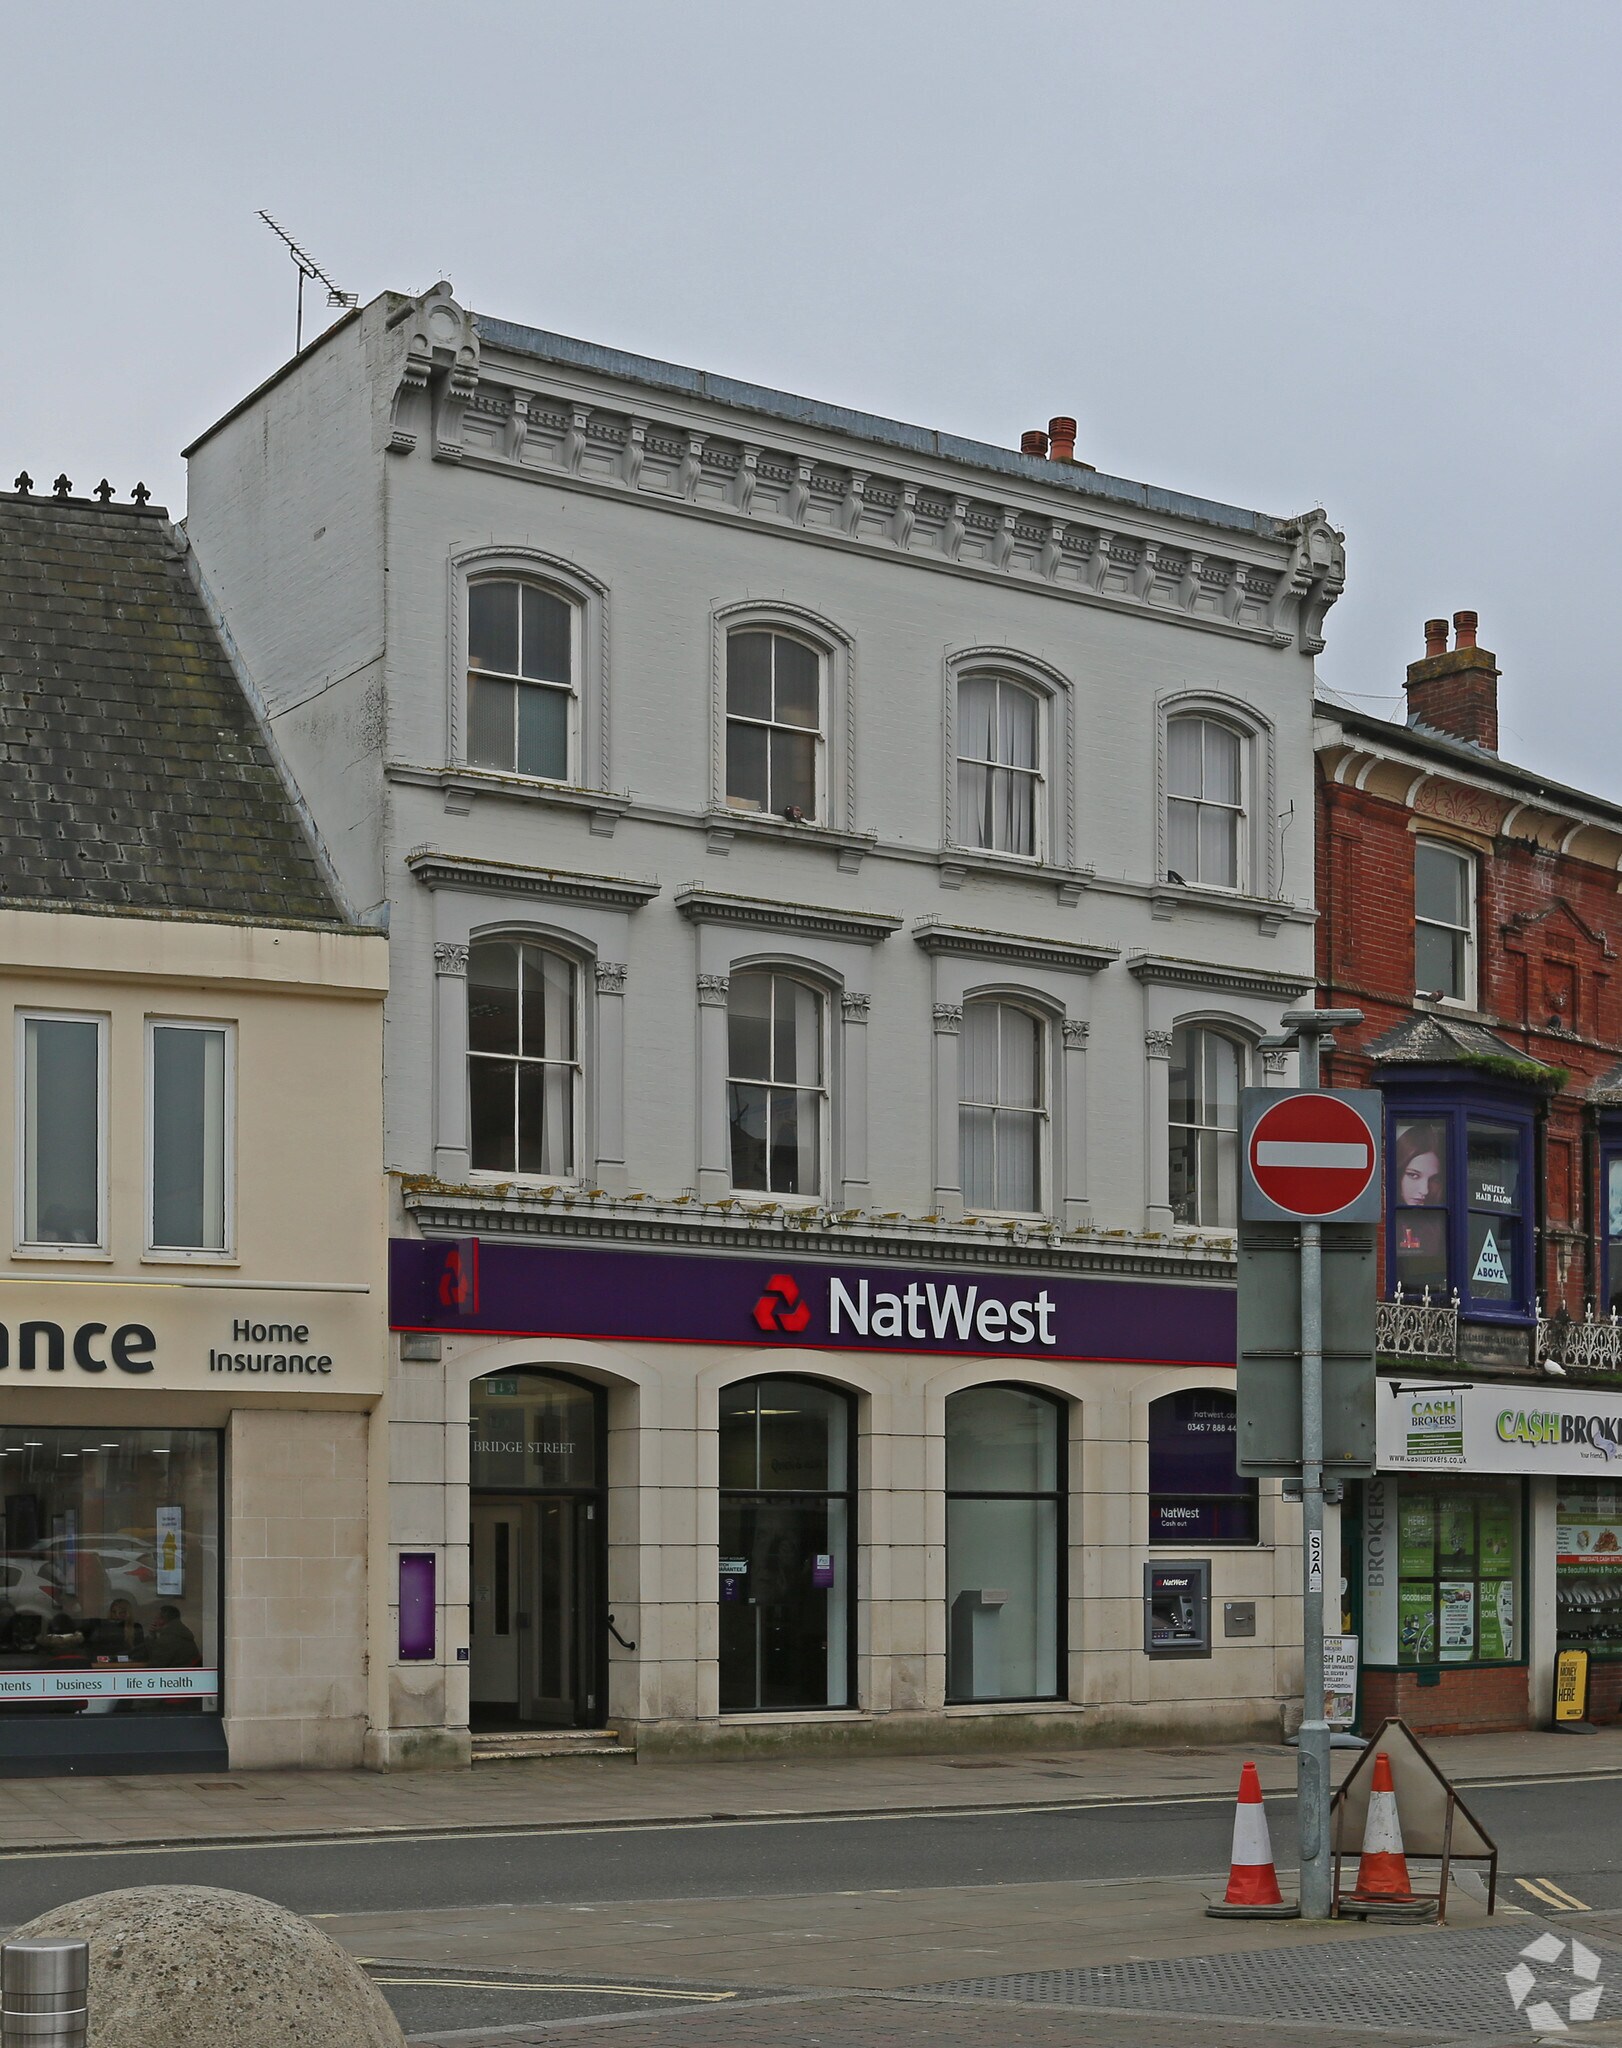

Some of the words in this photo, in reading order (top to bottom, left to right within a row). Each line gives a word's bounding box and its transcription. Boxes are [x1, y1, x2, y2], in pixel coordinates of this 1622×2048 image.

[1482, 1183, 1505, 1194] UNISEX
[1475, 1192, 1492, 1202] HAIR
[1493, 1194, 1512, 1204] SALON
[1487, 1239, 1493, 1248] A
[1482, 1252, 1498, 1262] CUT
[1477, 1268, 1504, 1279] ABOVE
[829, 1277, 1056, 1345] NatWest
[233, 1319, 309, 1343] Home
[0, 1321, 157, 1374] nce
[210, 1349, 333, 1374] Insurance
[1411, 1414, 1456, 1427] BROKERS
[1187, 1423, 1205, 1431] 0345
[1206, 1423, 1211, 1431] 7
[1212, 1424, 1226, 1432] 888
[473, 1440, 523, 1453] BRIDGE
[527, 1442, 576, 1454] STREET
[1160, 1507, 1200, 1519] NatWest
[1367, 1480, 1385, 1587] BROKERS
[1481, 1582, 1496, 1594] BUY
[1481, 1610, 1497, 1618] SOME
[1336, 1655, 1354, 1663] PAID
[1560, 1667, 1576, 1677] MONEY
[56, 1679, 102, 1690] business
[126, 1677, 143, 1689] life
[147, 1678, 155, 1688] &
[159, 1676, 193, 1688] health
[1558, 1687, 1576, 1702] HERE
